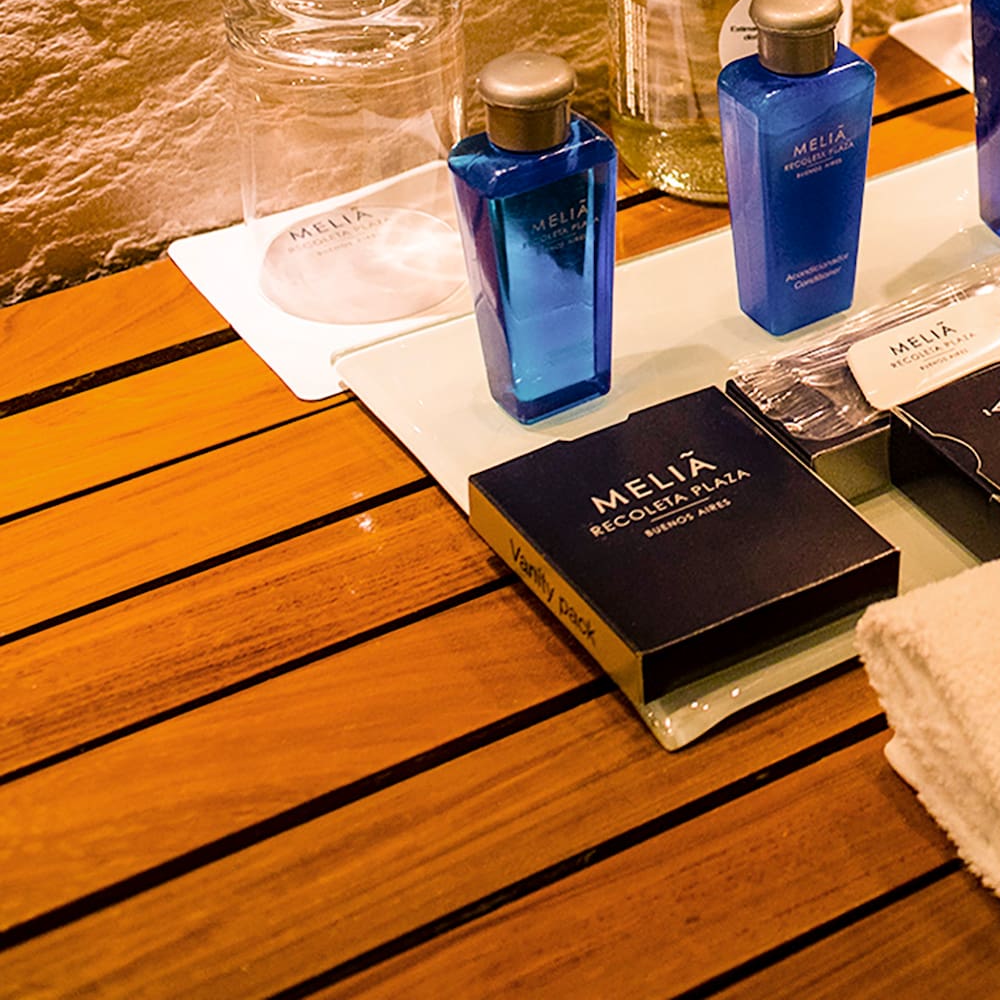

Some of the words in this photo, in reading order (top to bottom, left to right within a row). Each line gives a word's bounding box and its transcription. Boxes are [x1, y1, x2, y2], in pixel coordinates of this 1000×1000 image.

[589, 493, 689, 538] RECOLETA
[690, 469, 751, 497] PLAZA
[643, 513, 694, 538] BUENOS
[697, 498, 732, 517] AIRES
[509, 538, 555, 603] Vanity
[558, 596, 596, 649] pack
